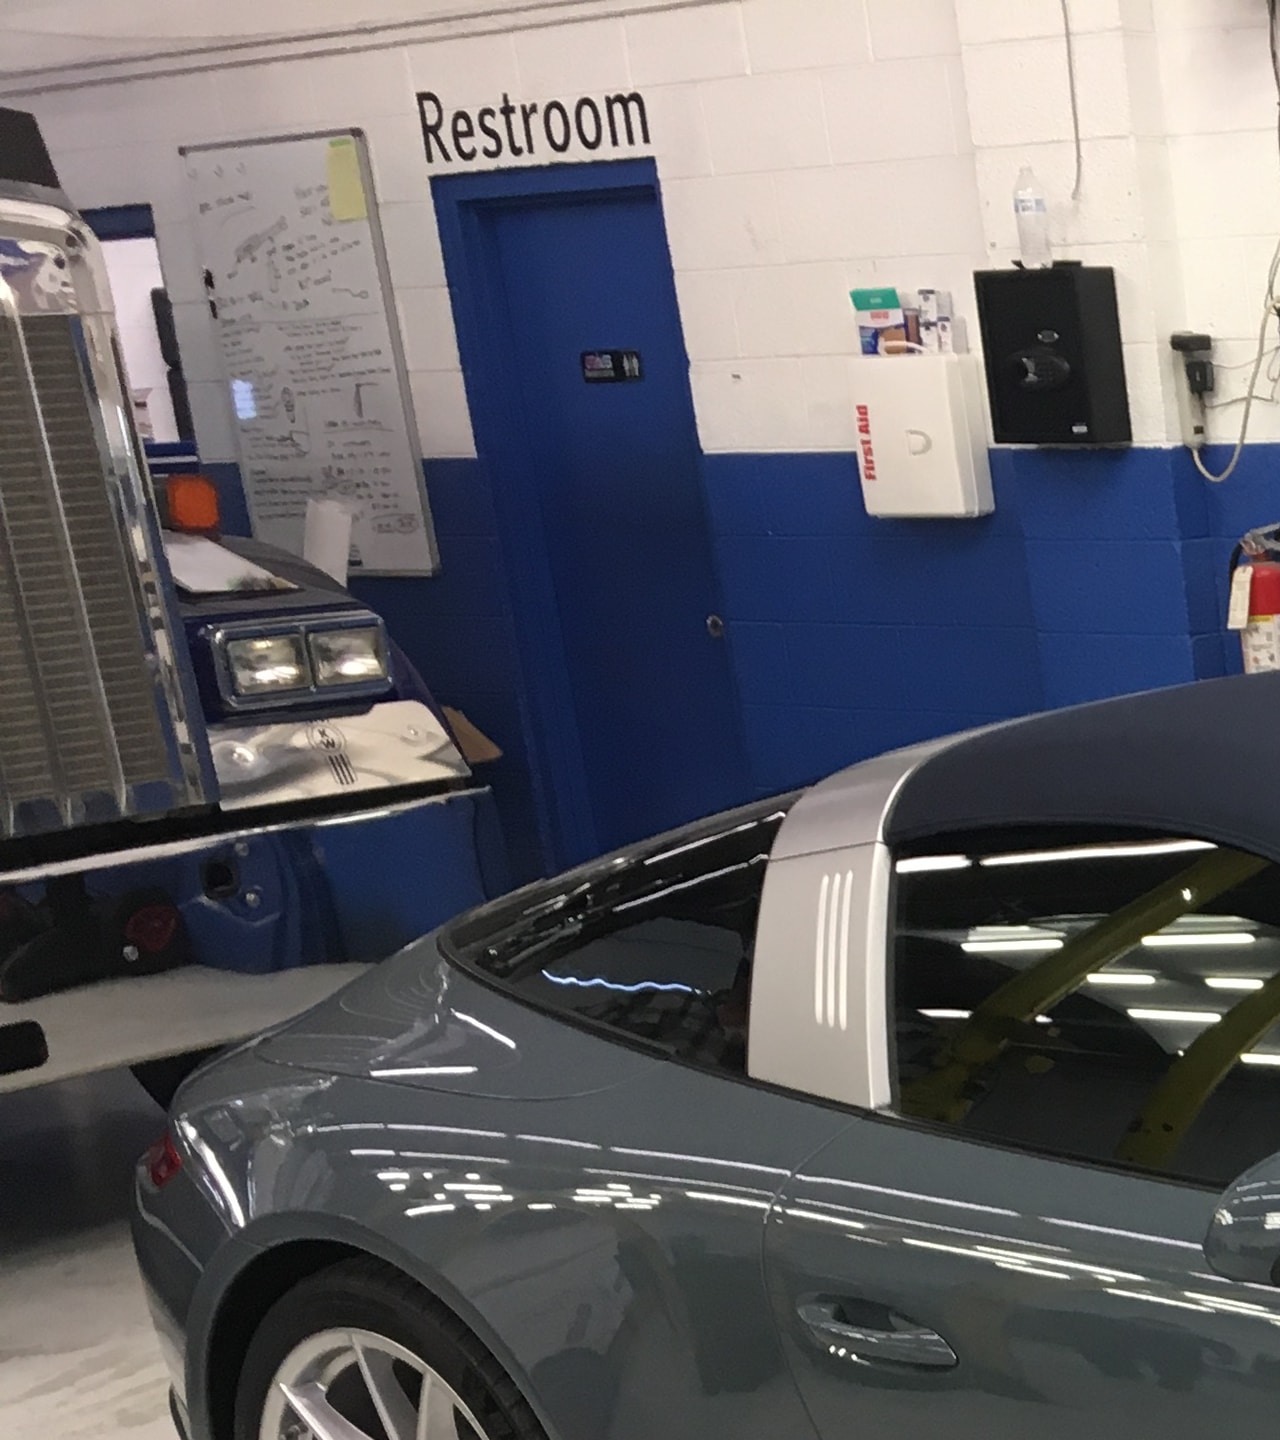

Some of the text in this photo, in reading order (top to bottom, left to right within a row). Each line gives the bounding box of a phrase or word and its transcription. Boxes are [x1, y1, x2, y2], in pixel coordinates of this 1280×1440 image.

[415, 91, 652, 164] Restroom
[856, 404, 877, 481] First Aid
